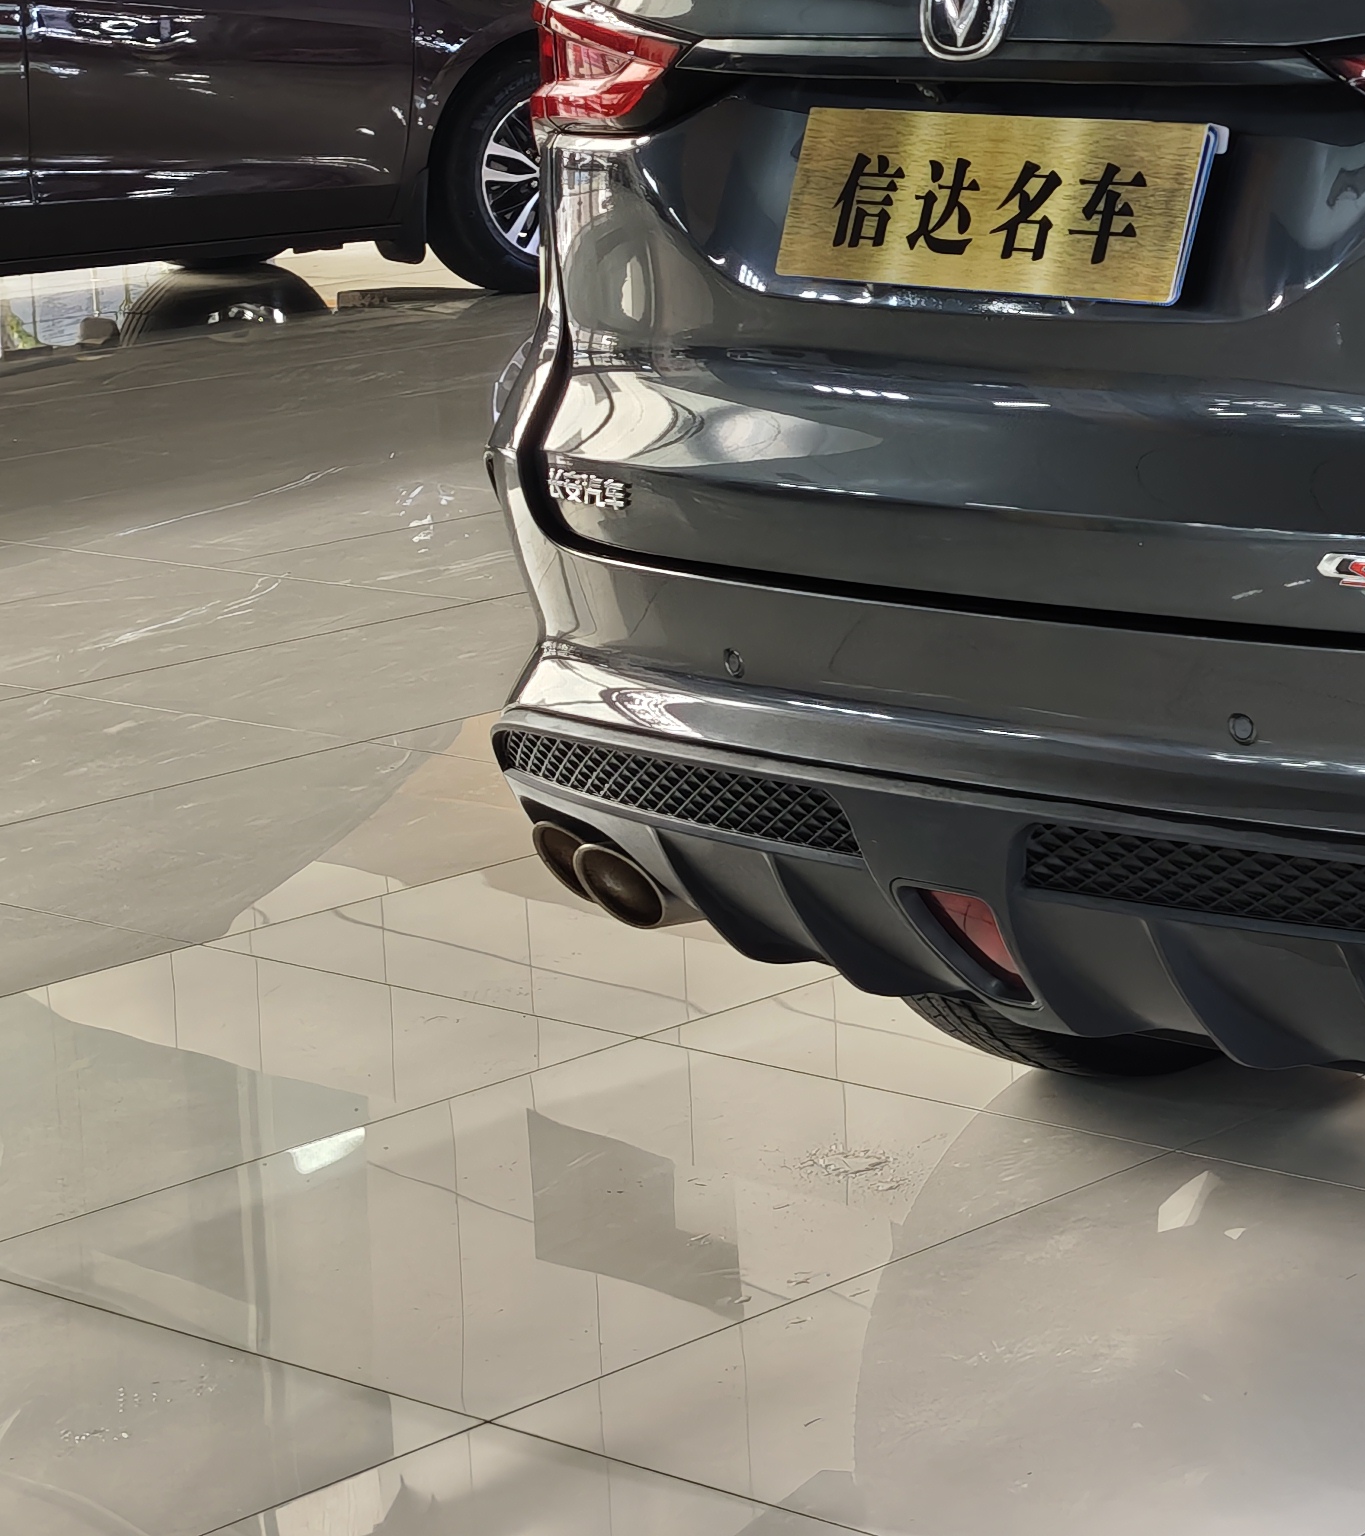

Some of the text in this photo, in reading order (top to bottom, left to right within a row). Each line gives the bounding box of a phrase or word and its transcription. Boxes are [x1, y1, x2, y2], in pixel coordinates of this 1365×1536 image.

[831, 152, 1148, 265] 信达名车
[547, 467, 626, 511] 长安汽车
